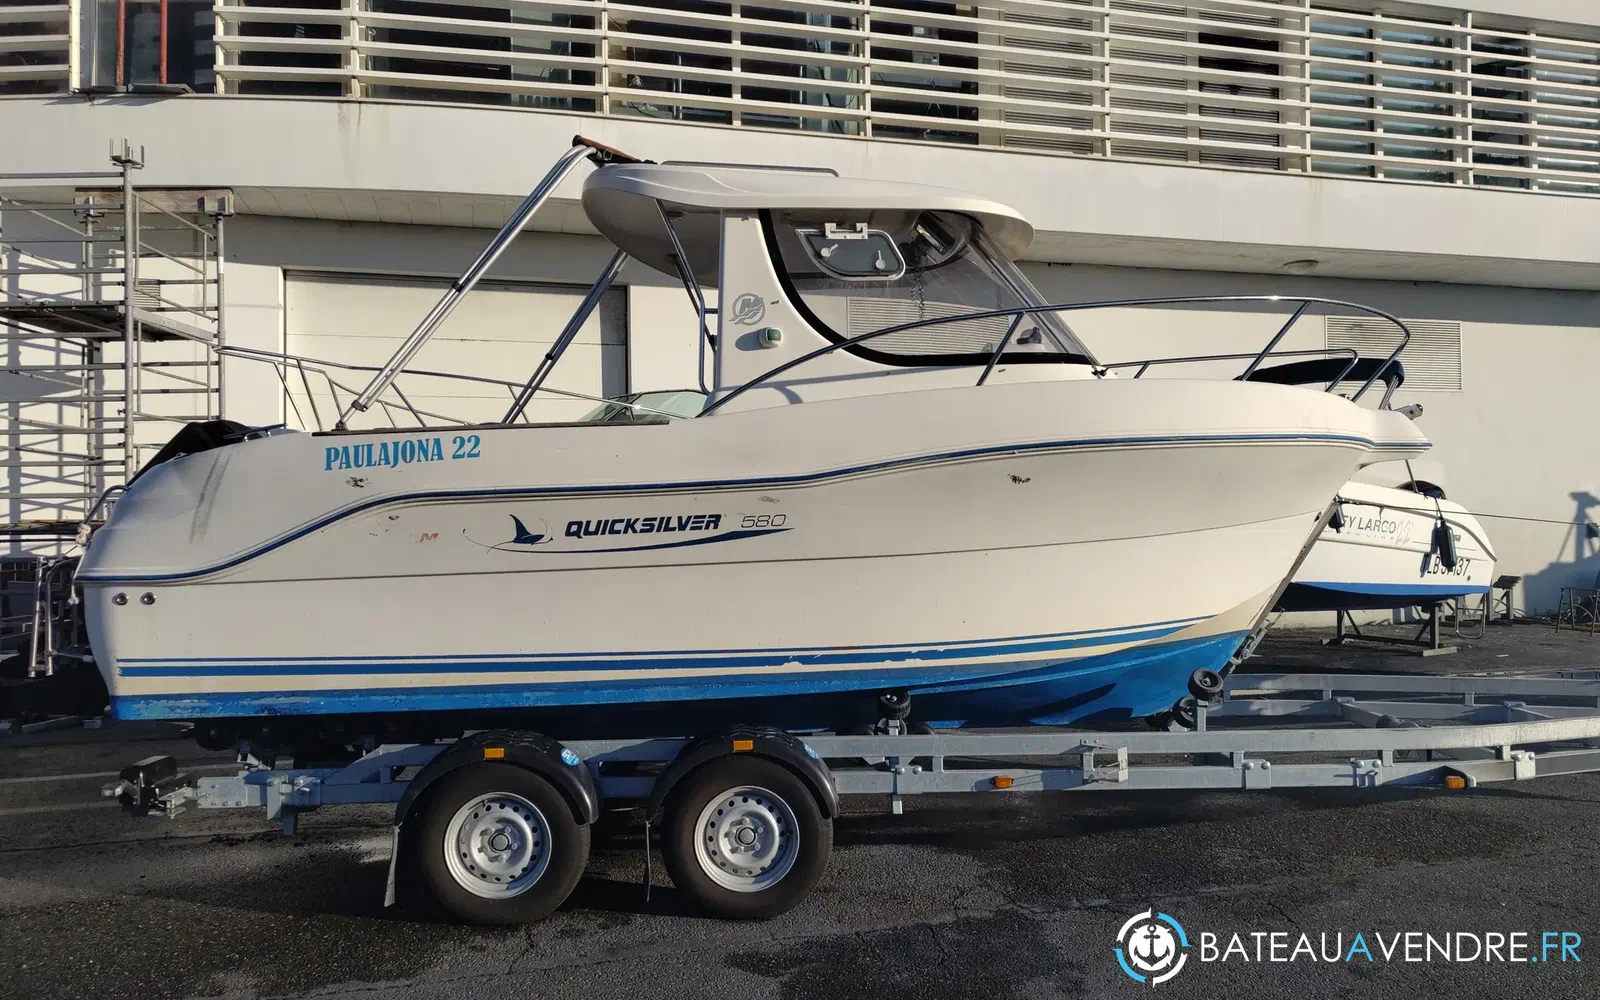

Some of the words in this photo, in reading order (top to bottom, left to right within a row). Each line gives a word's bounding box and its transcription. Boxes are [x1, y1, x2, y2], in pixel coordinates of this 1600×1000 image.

[325, 437, 444, 471] PAULAJONA
[452, 435, 481, 459] 22
[565, 514, 722, 538] QUICKSILVER
[741, 514, 787, 528] 580
[1357, 516, 1397, 534] LARGO
